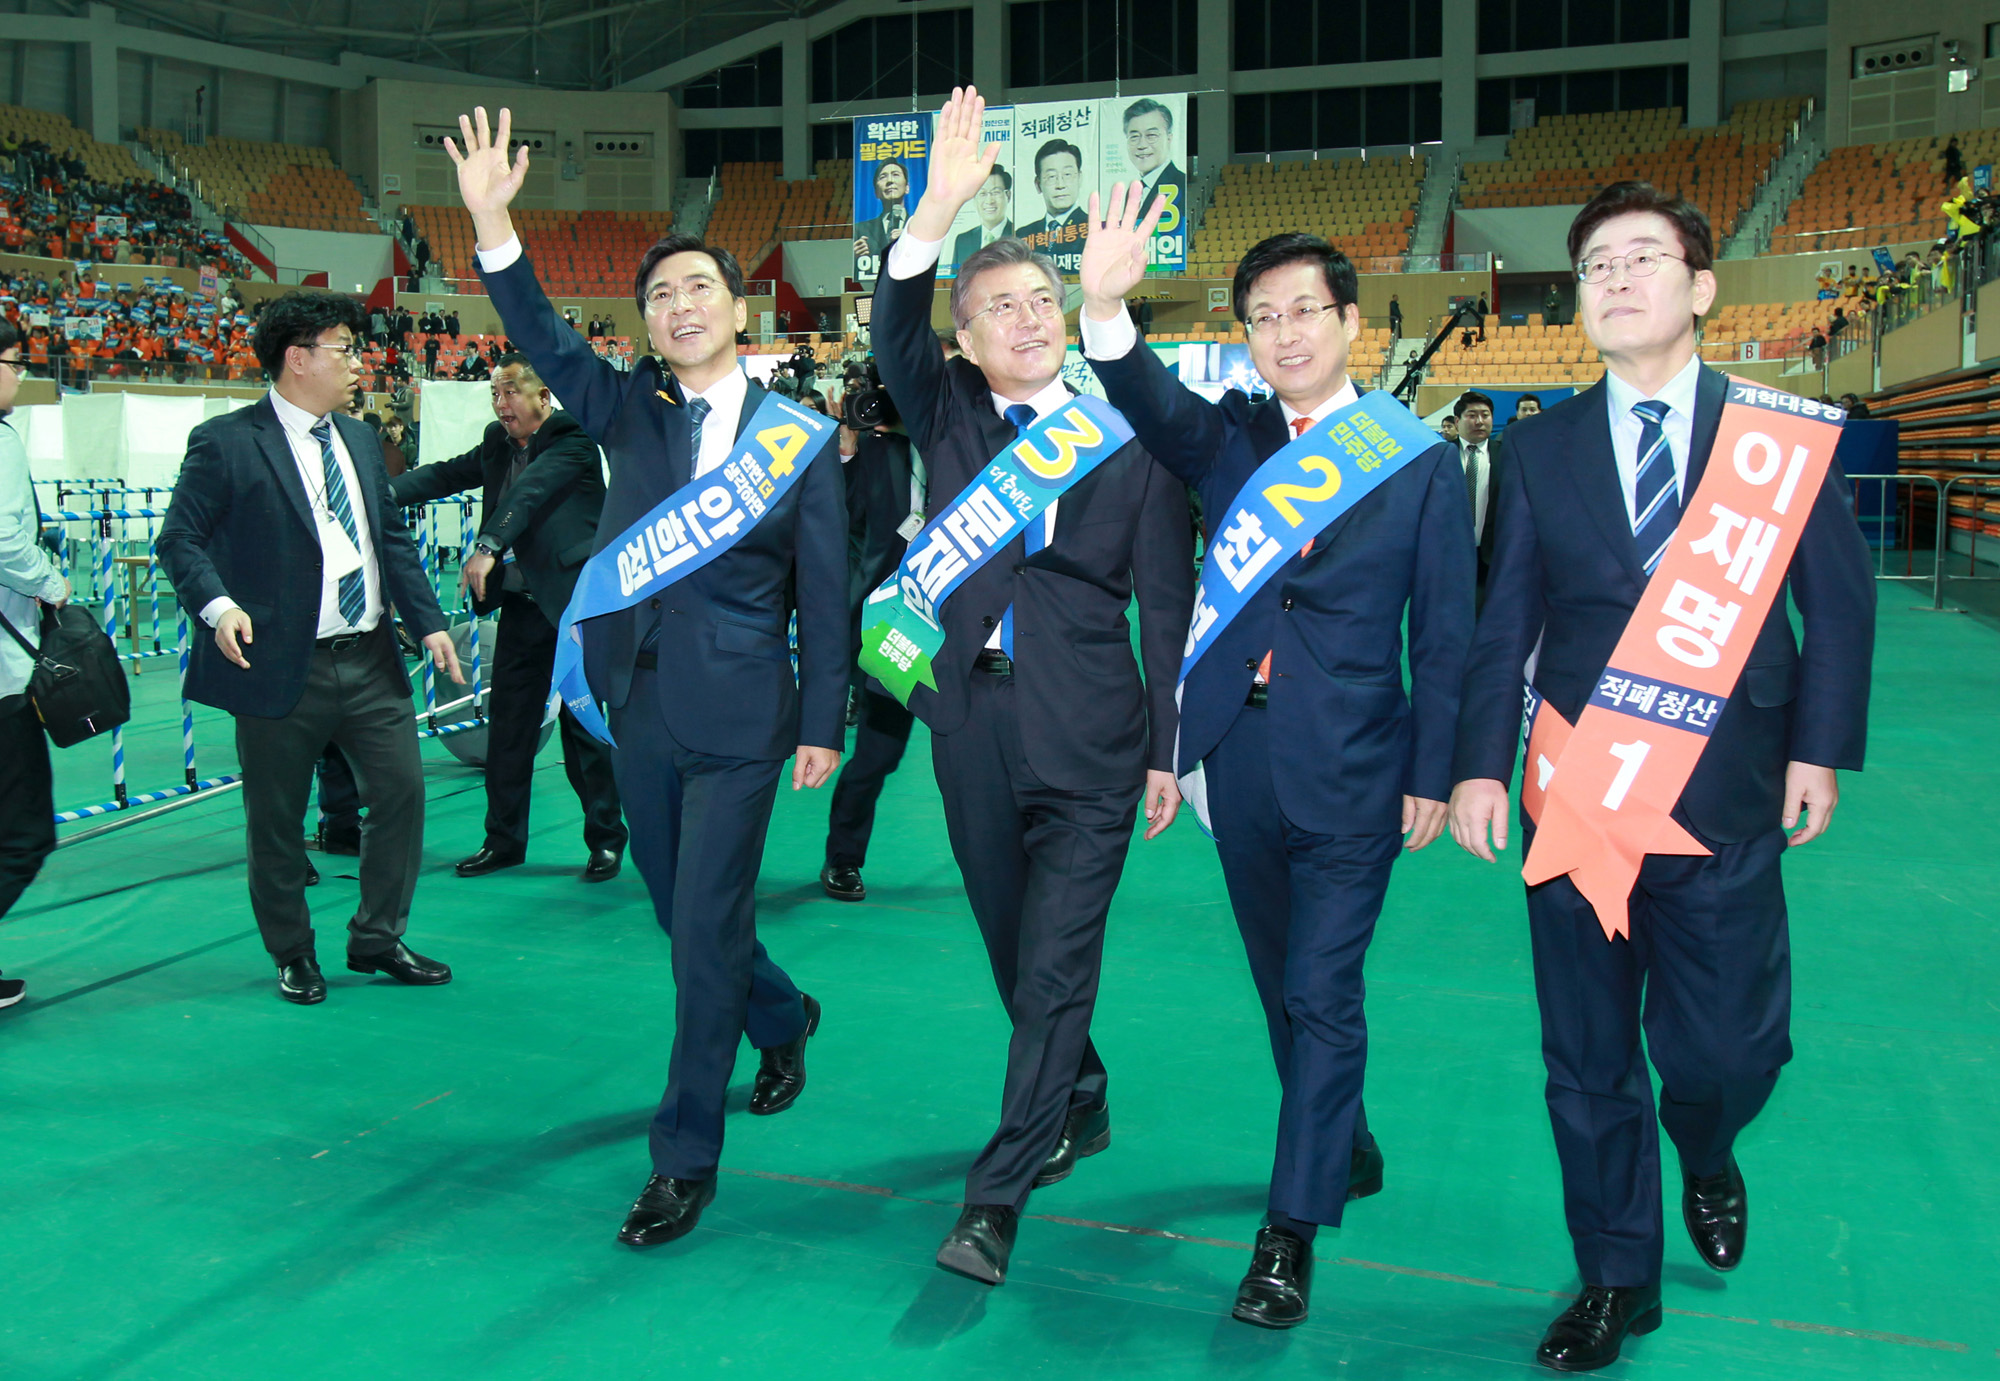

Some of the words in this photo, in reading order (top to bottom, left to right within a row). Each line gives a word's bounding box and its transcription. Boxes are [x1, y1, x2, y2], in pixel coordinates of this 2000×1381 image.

[867, 120, 919, 141] 확실한
[984, 129, 1010, 142] 시대!
[1021, 105, 1092, 139] 적폐청산
[860, 140, 926, 161] 필승카드
[1157, 183, 1180, 232] 3
[1745, 344, 1754, 360] B
[755, 422, 810, 481] 4
[1012, 406, 1104, 480] 3
[1327, 421, 1383, 473] 민주당
[1349, 411, 1403, 461] 더불어
[757, 478, 776, 500] 더
[989, 464, 1003, 486] 더
[1261, 454, 1342, 528] 2
[616, 486, 745, 597] 안희정
[1656, 431, 1808, 669] 이재명
[878, 639, 913, 673] 민주당
[885, 627, 922, 662] 더불어
[1599, 674, 1718, 728] 적폐청산
[1600, 739, 1652, 811] 1
